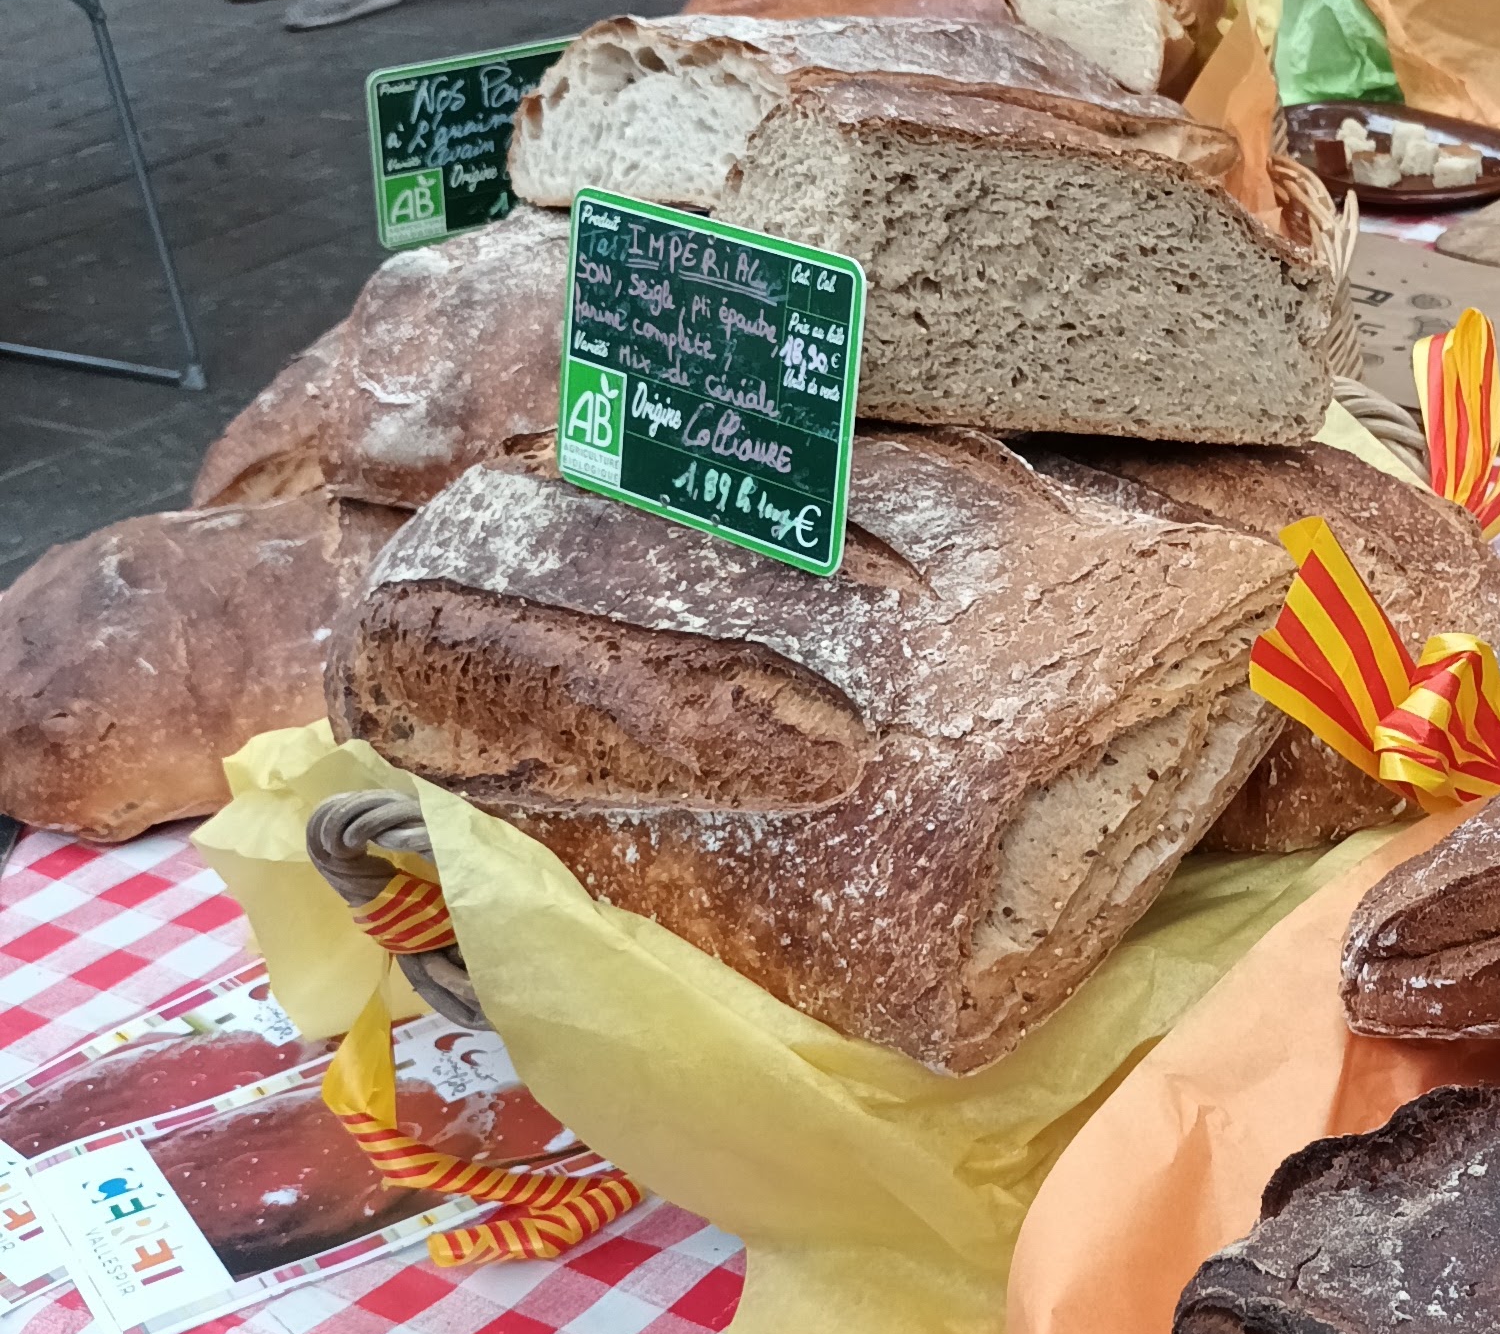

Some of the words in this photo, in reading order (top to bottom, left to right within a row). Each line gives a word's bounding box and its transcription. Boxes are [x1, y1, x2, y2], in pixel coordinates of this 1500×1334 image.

[391, 186, 436, 224] AB
[568, 389, 612, 448] AB
[631, 382, 683, 437] Origine
[795, 504, 822, 548] €
[85, 1227, 136, 1297] VALLESPIR
